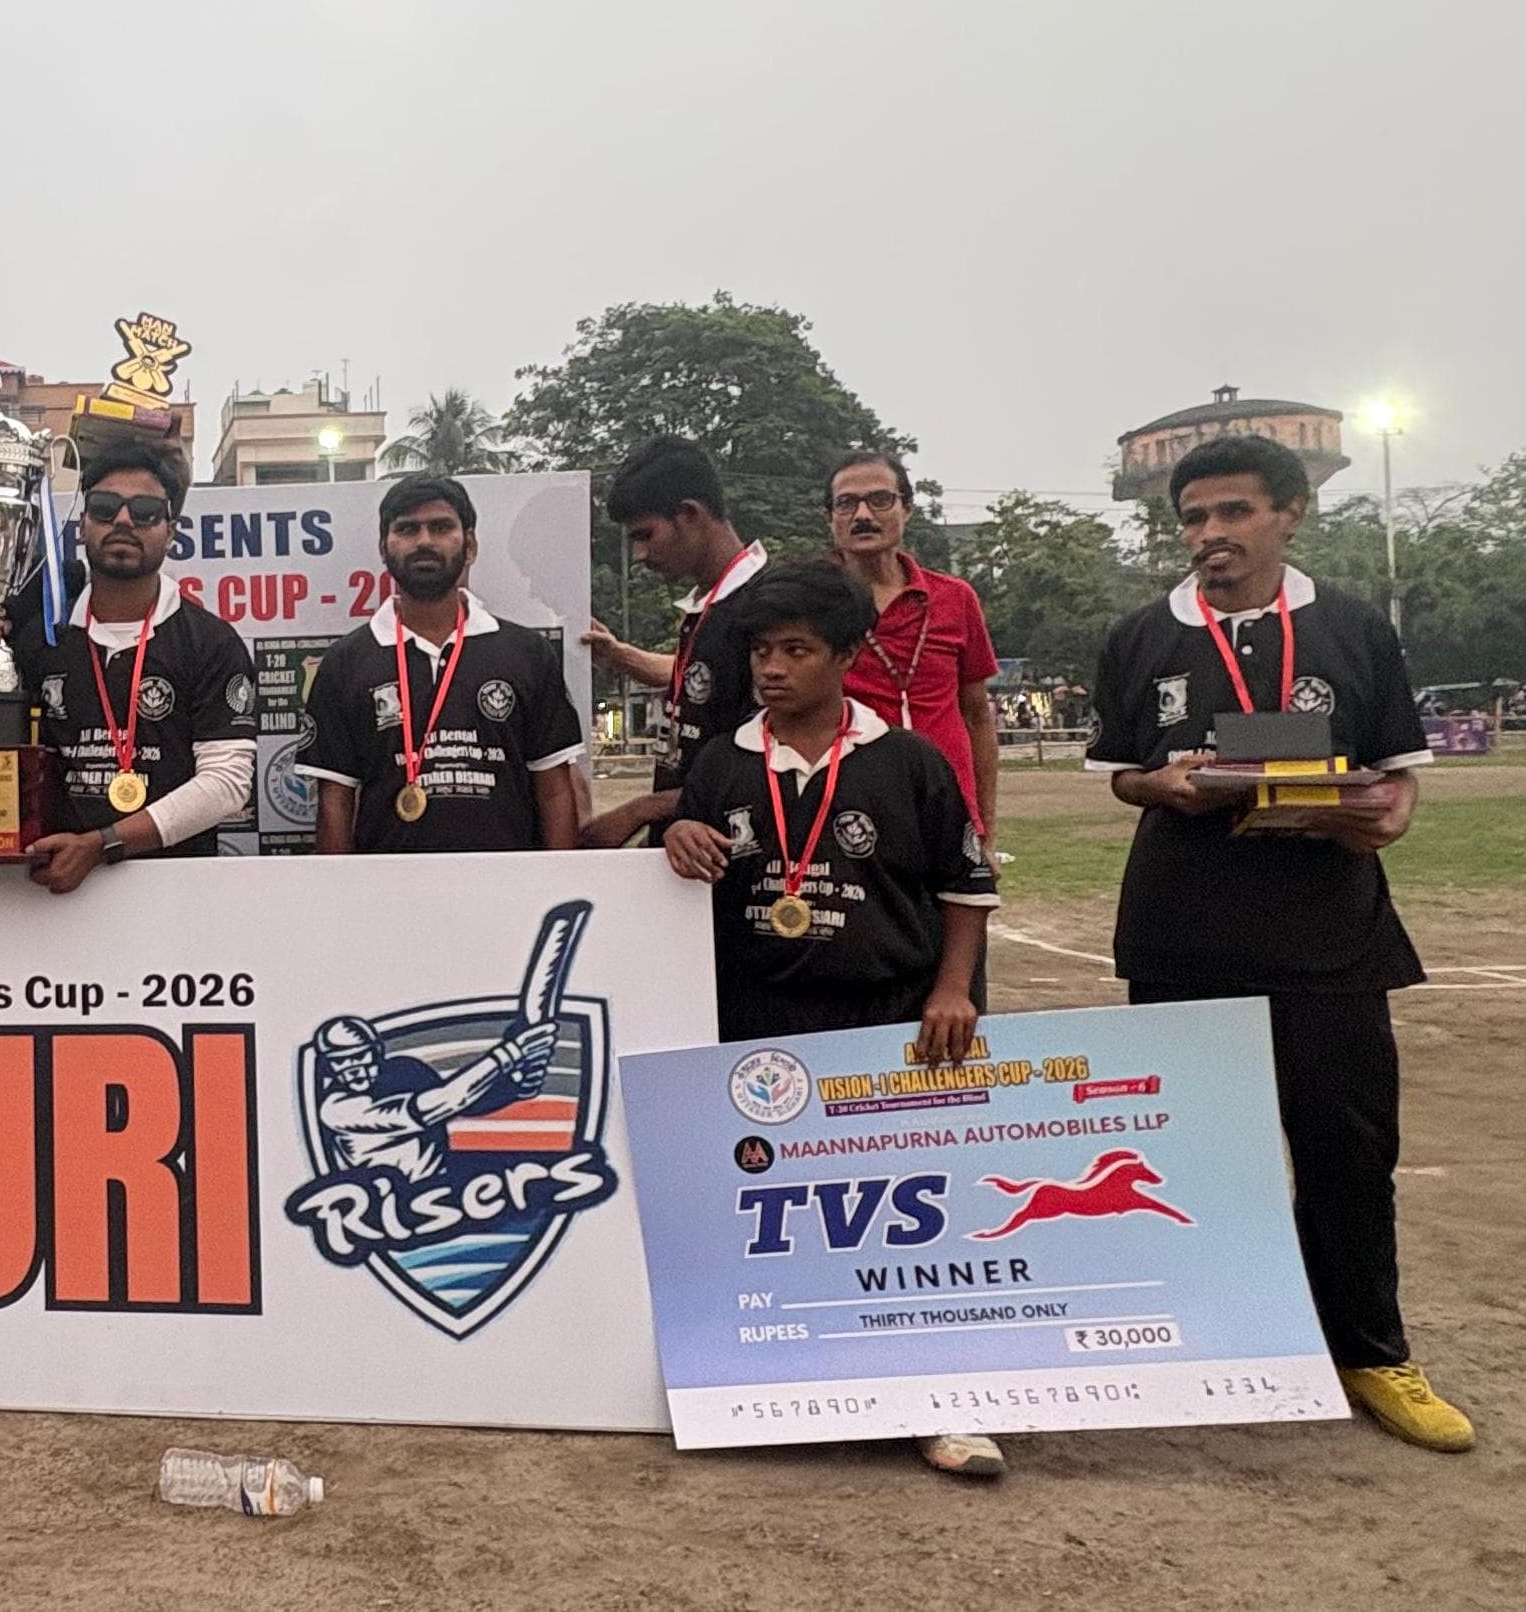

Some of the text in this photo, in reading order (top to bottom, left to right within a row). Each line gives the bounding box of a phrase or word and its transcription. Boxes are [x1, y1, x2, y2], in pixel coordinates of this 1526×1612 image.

[130, 324, 178, 348] MATCH
[141, 315, 173, 336] MAN
[218, 573, 308, 624] CUP
[321, 595, 336, 603] -
[258, 670, 296, 684] CRICKET
[260, 712, 296, 731] BLIND
[24, 974, 105, 1016] Cup
[141, 972, 256, 1008] 2026
[817, 1074, 874, 1102] VISION
[889, 1063, 998, 1096] CHALLENGERS
[998, 1060, 1032, 1087] CUP
[1042, 1055, 1090, 1084] 2026
[780, 1130, 958, 1160] MAANNAPURNA
[964, 1116, 1127, 1148] AUTOMOBILES
[1133, 1113, 1171, 1132] LLP
[296, 1152, 605, 1255] Risers
[738, 1174, 948, 1256] TVS
[855, 1258, 1034, 1292] WINNER
[738, 1292, 774, 1311] PAY
[859, 1302, 1069, 1330] THIRTY THOUSAND ONLY
[739, 1323, 810, 1344] RUPEES
[1095, 1326, 1172, 1349] 30,000
